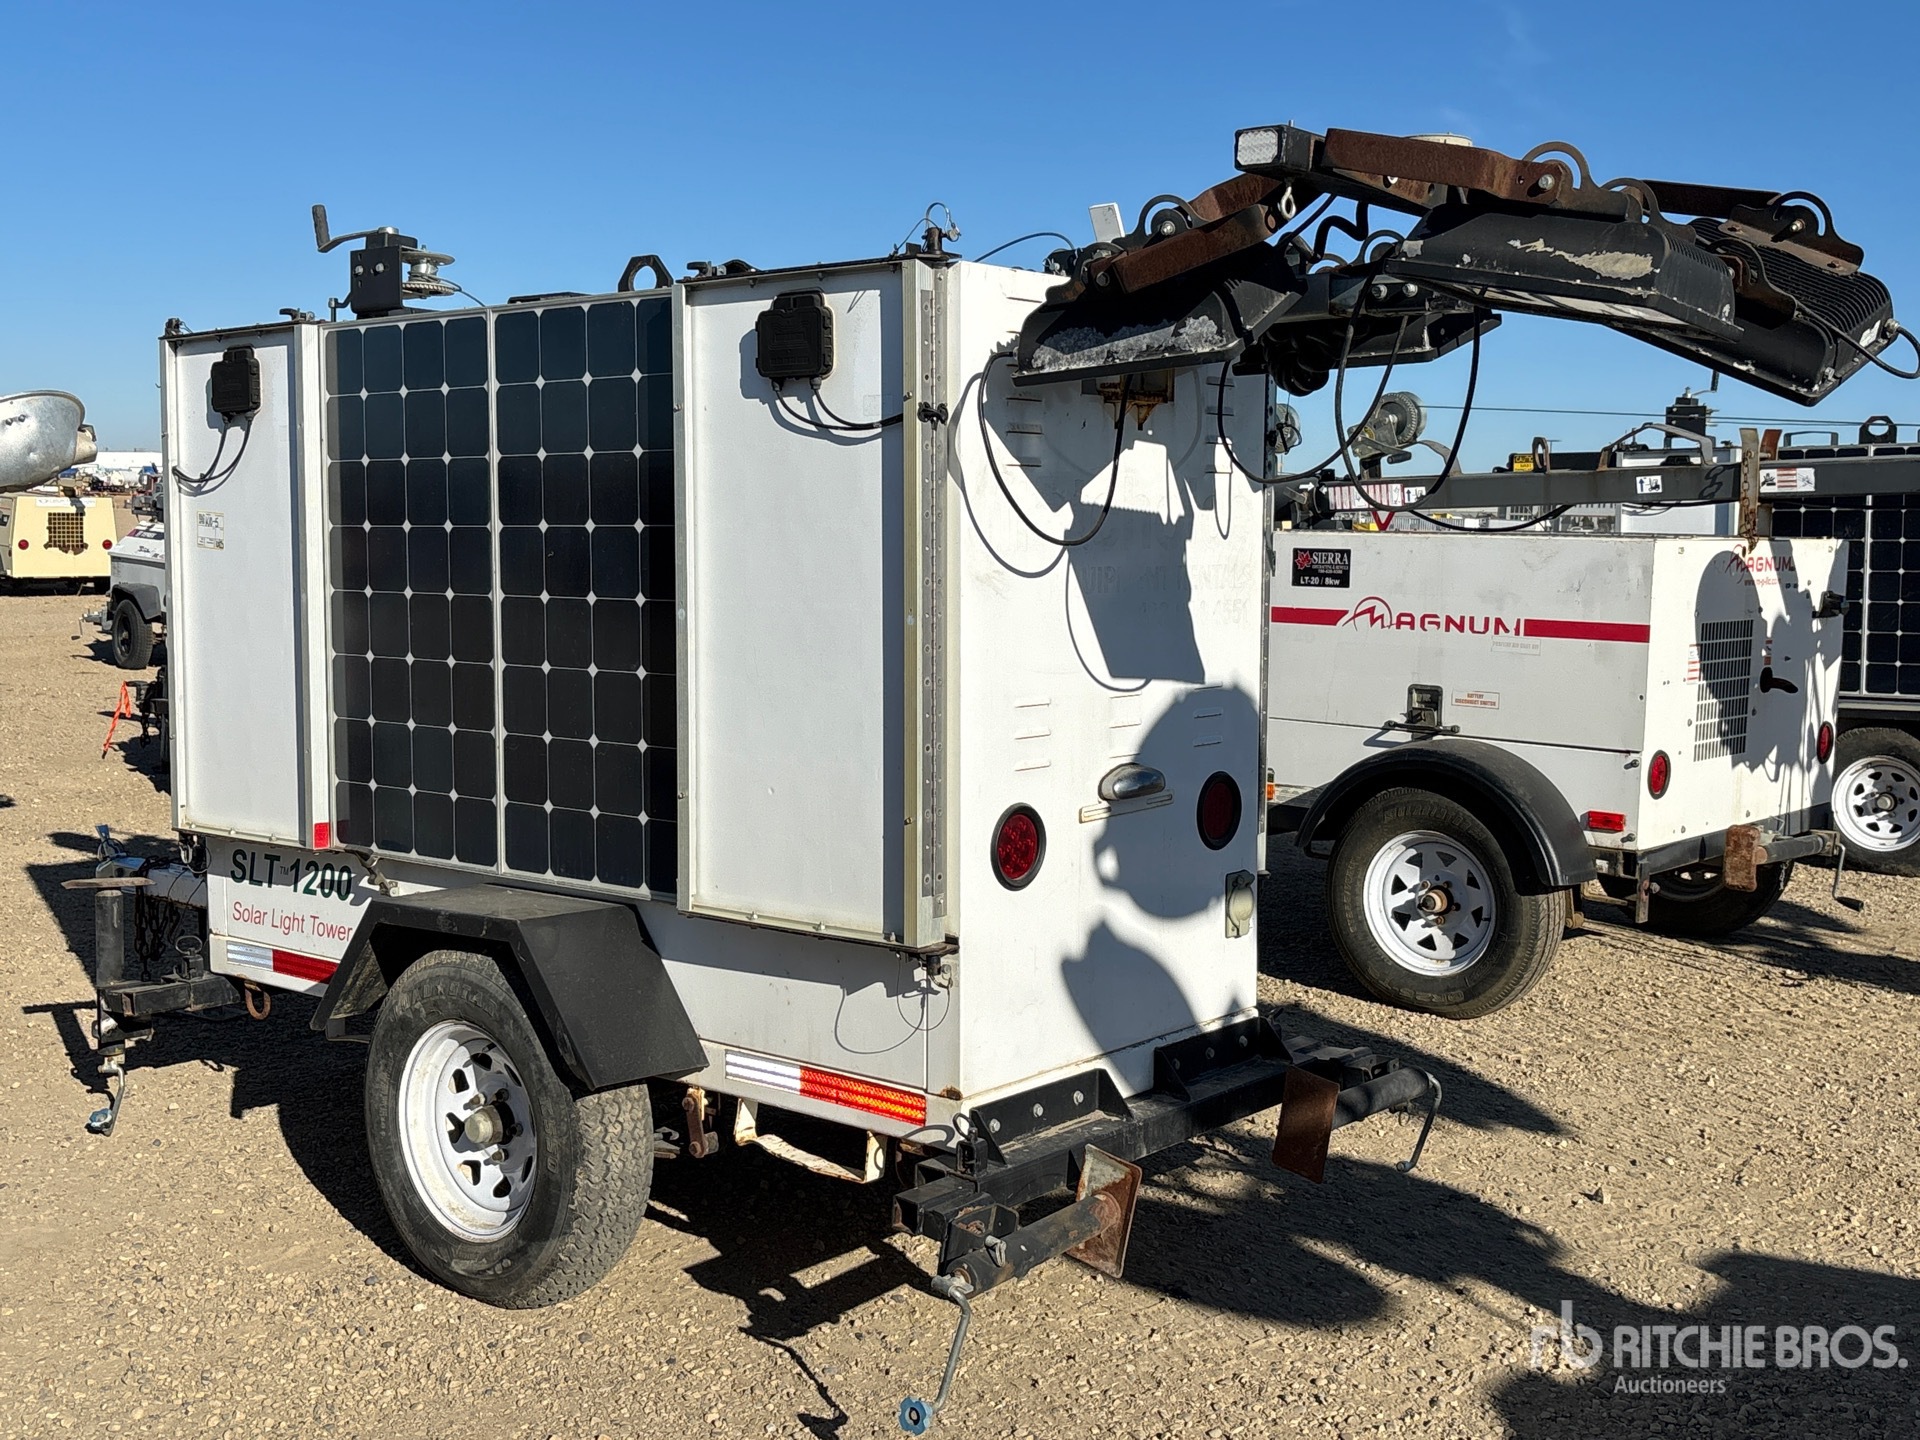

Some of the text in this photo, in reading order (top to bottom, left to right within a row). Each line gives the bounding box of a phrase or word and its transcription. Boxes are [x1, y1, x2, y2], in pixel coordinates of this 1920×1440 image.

[1312, 551, 1349, 564] SIERRA
[1300, 576, 1320, 585] LT-20
[1342, 597, 1521, 637] MAGNUM
[230, 849, 281, 888] SLT
[290, 858, 353, 901] 1200
[233, 901, 353, 942] Solar Light Tower
